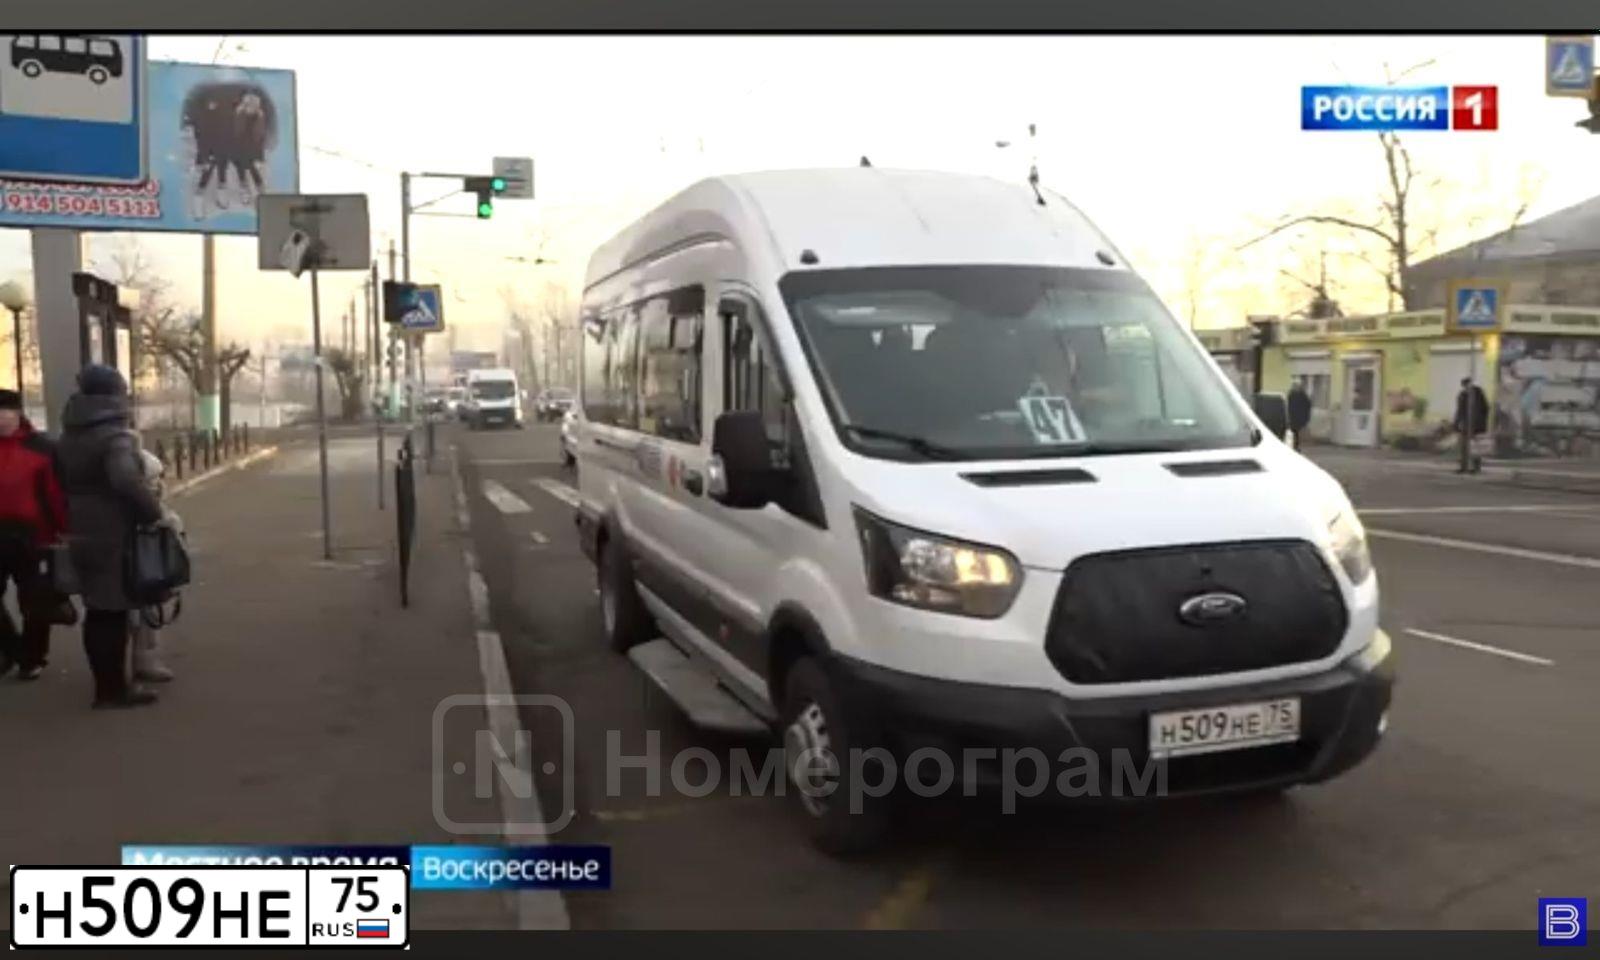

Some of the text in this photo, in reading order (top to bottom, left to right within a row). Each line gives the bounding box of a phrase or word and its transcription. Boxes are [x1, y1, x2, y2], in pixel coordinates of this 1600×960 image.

[7, 194, 51, 211] 914
[57, 195, 102, 214] 504
[1029, 399, 1078, 440] 47
[1160, 702, 1292, 744] Н509НЕ 75
